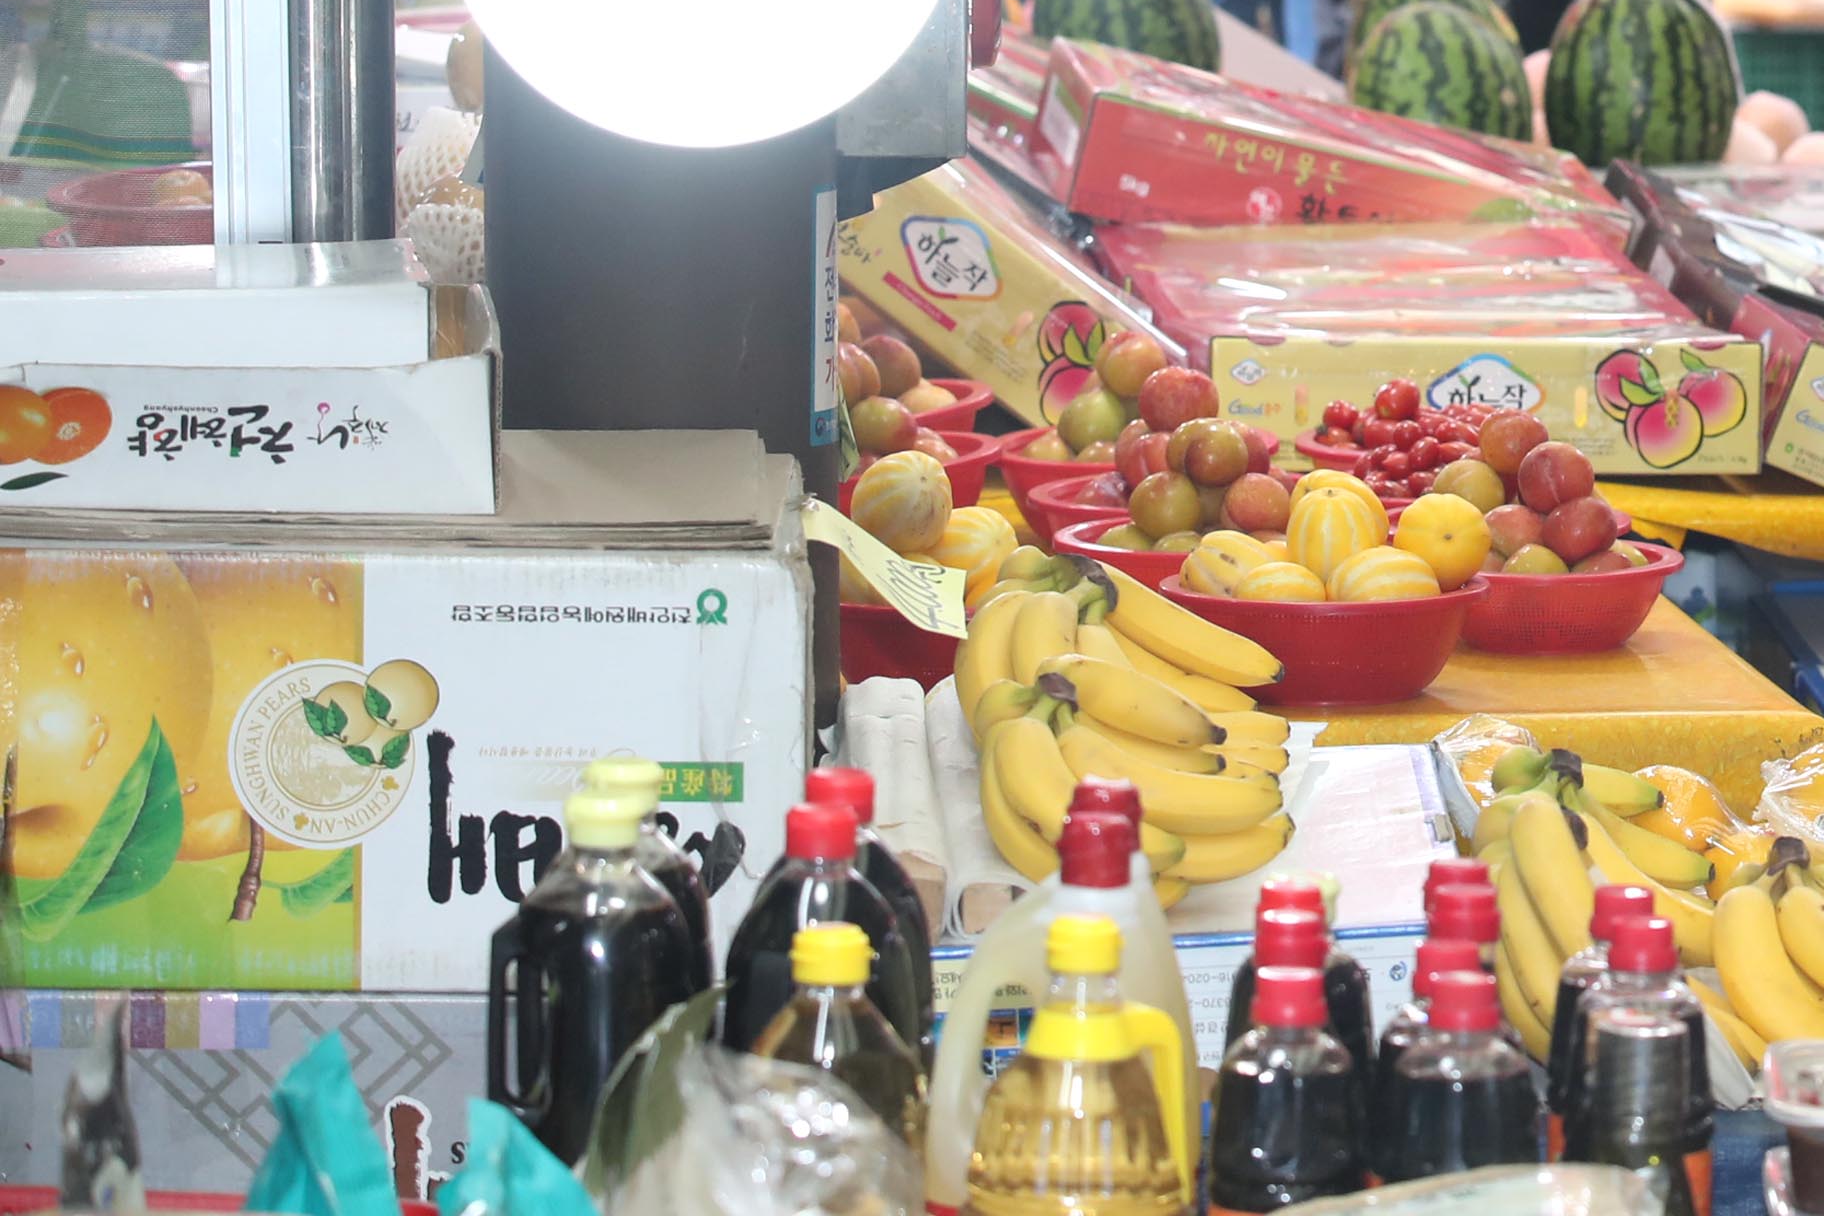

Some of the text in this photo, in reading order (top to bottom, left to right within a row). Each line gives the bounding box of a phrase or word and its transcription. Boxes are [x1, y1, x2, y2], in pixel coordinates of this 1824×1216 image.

[1204, 132, 1284, 174] 자연이
[916, 229, 992, 291] 하늘작
[127, 404, 294, 464] 천혜향
[452, 605, 692, 625] 천안배원예농업협동조합
[243, 676, 314, 821] SUNGHWAN PEARS
[310, 791, 392, 835] CHUN-AN
